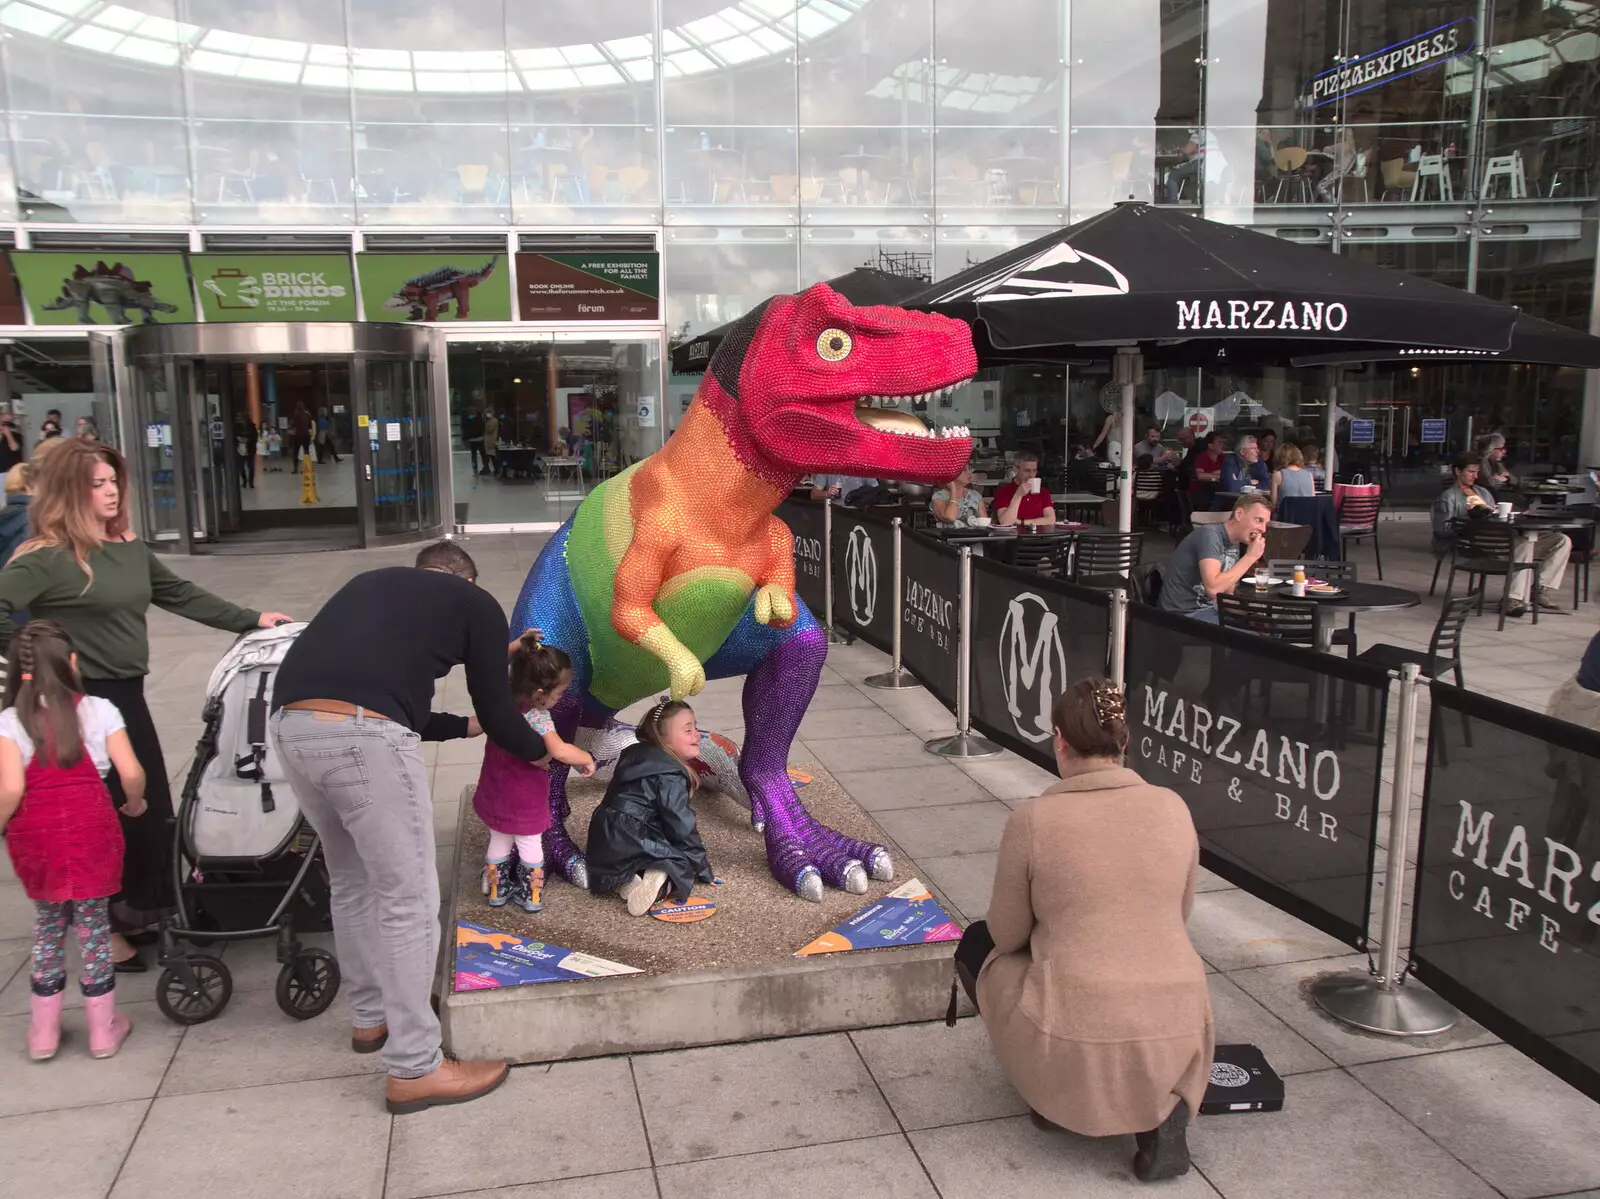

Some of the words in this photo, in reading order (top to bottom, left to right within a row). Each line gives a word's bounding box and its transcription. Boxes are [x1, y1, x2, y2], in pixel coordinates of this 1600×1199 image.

[1313, 28, 1459, 100] PIZZAEXPRESS
[261, 272, 326, 285] BRICK
[264, 285, 346, 298] DINOS
[1176, 300, 1348, 331] MARZANO
[1143, 684, 1341, 801] MARZANO
[1141, 736, 1203, 785] CAFE
[1227, 777, 1244, 803] &
[1275, 792, 1338, 842] BAR
[1452, 800, 1600, 926] MAR
[660, 905, 707, 914] CAUTION
[1449, 870, 1561, 954] CAFE
